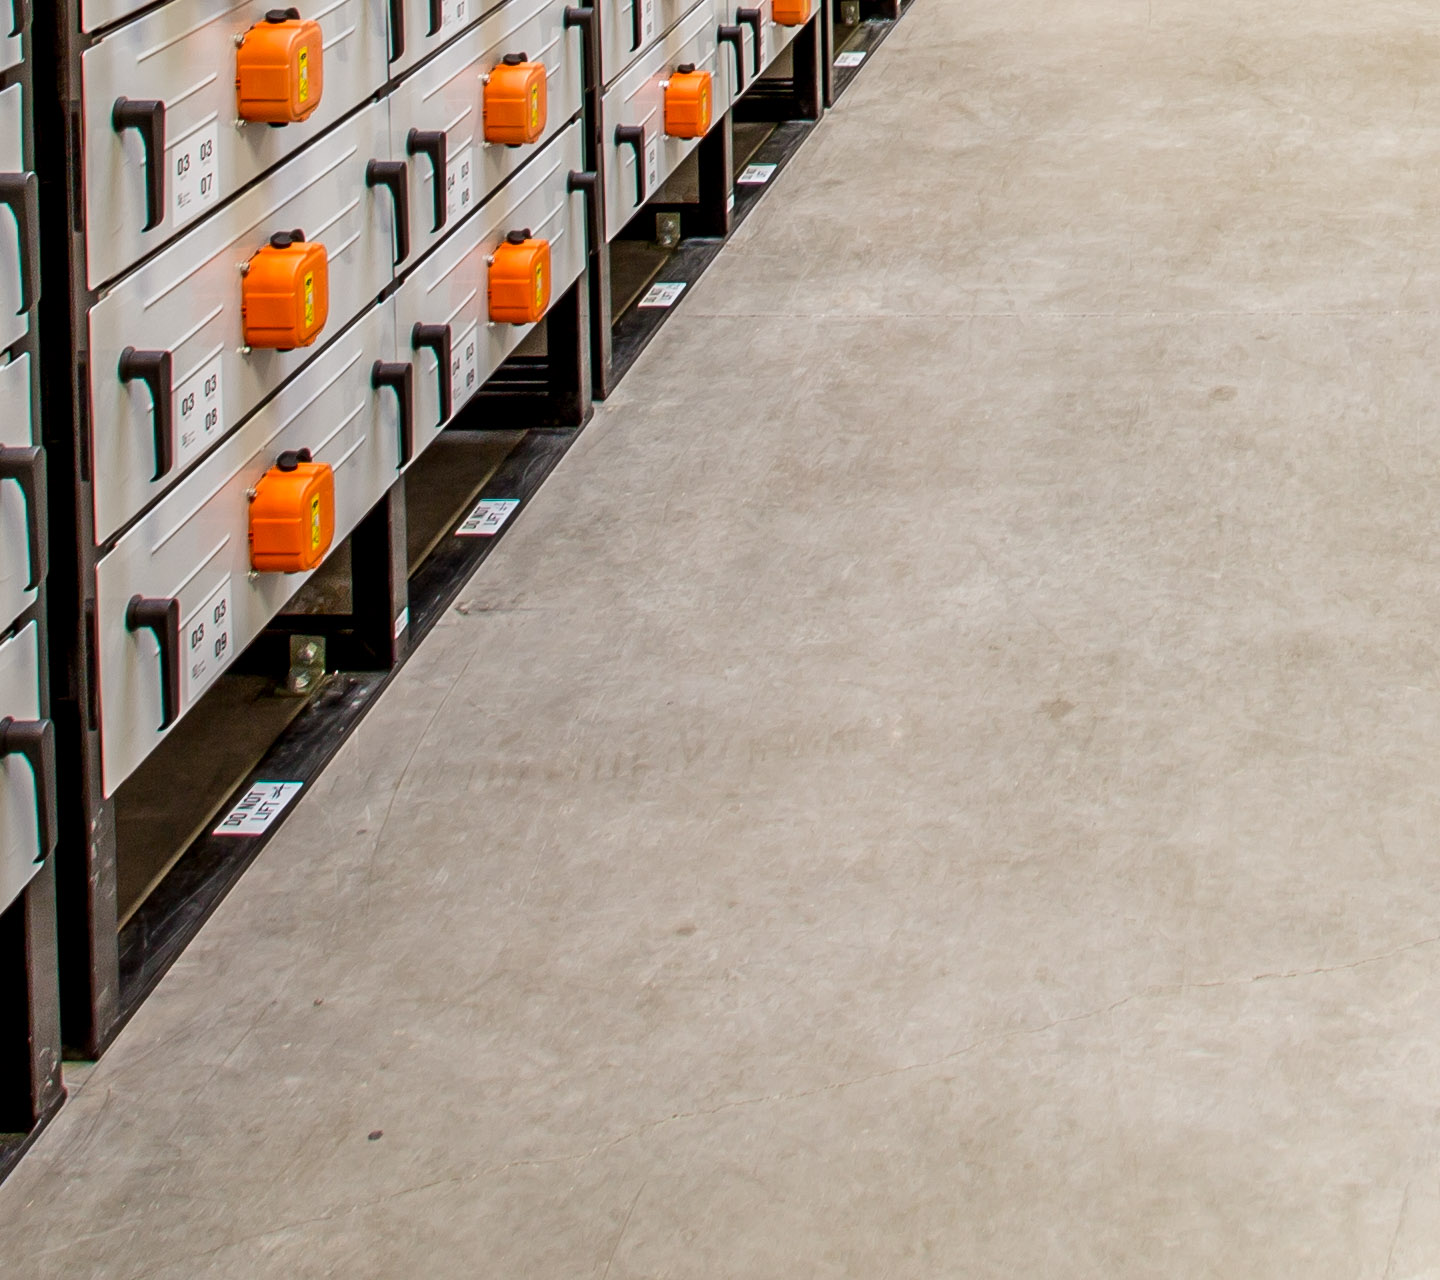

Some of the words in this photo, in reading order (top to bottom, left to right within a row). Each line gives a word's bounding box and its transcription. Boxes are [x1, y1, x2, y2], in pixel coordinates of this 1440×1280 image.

[204, 373, 217, 398] 03
[181, 392, 195, 417] 03
[204, 407, 218, 432] 08
[214, 599, 227, 625] 03
[191, 622, 205, 651] 03
[214, 631, 228, 659] 09
[223, 813, 248, 827] DO
[236, 792, 265, 810] NOT
[250, 801, 279, 820] LIFT
